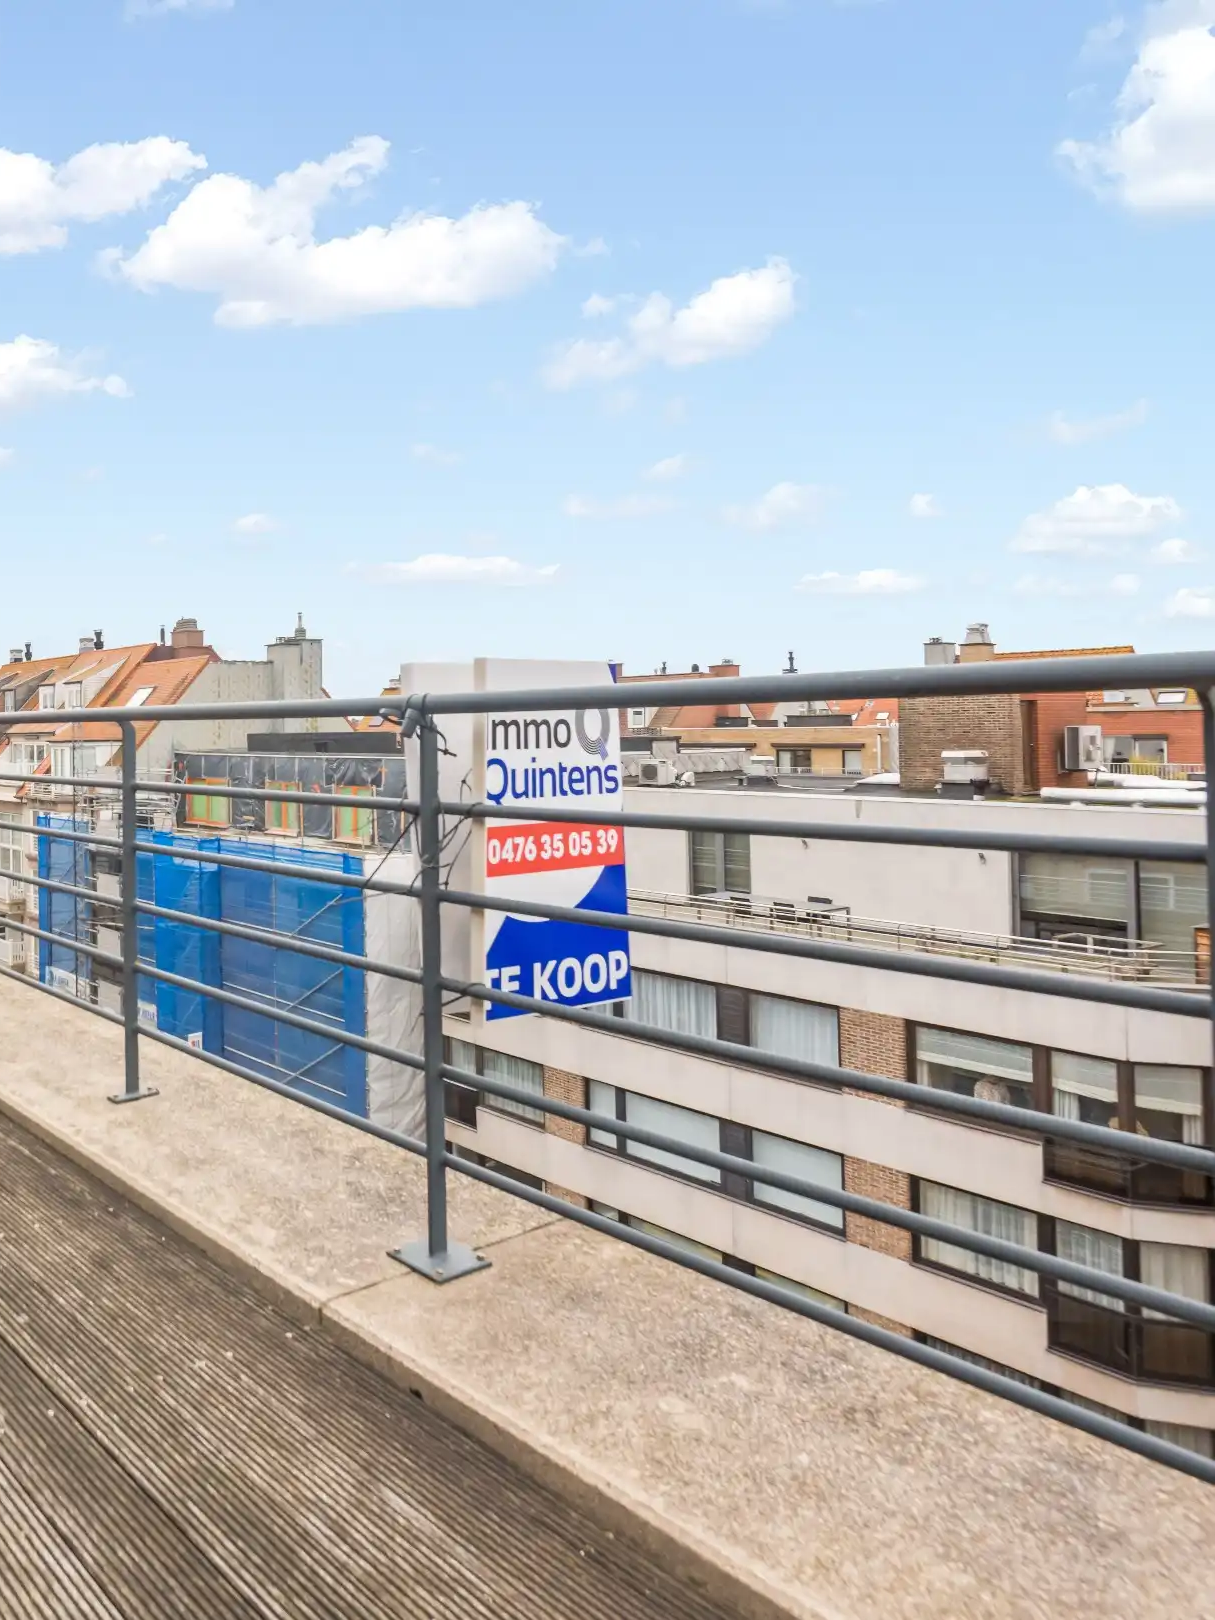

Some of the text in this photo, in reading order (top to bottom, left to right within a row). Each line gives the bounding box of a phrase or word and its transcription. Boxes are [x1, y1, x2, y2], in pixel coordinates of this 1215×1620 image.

[486, 712, 571, 750] mmo
[486, 756, 619, 806] Quintens
[487, 828, 619, 865] 0476 35 05 39
[533, 950, 629, 1001] KOOP
